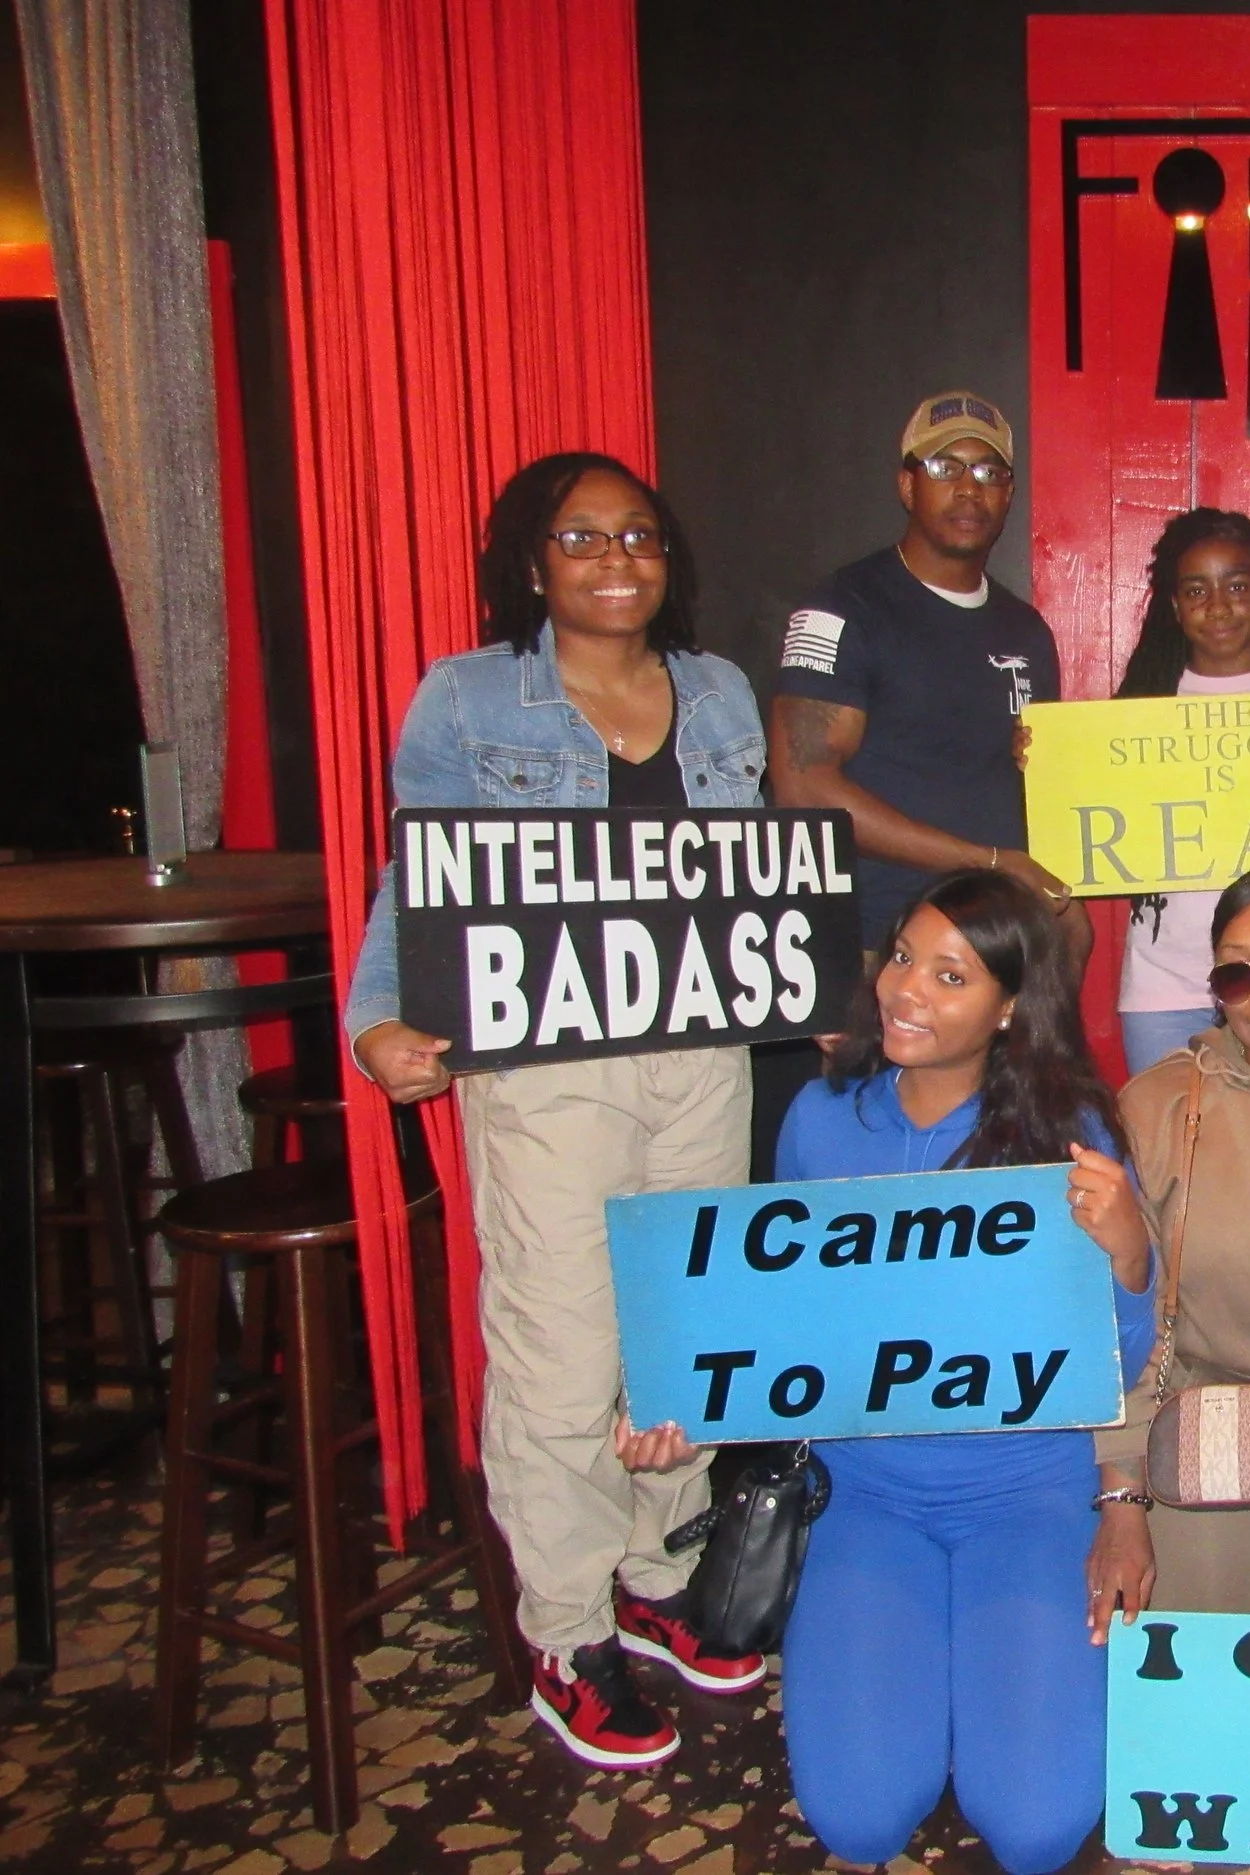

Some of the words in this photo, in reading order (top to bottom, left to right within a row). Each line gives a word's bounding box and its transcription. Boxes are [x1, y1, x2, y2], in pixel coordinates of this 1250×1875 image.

[1204, 765, 1236, 793] IS
[405, 820, 853, 909] INTELLECTUAL
[465, 910, 817, 1052] BADASS
[685, 1205, 719, 1278] I
[743, 1198, 1037, 1273] Came
[692, 1349, 826, 1423] To
[865, 1338, 1071, 1426] Pay
[1135, 1622, 1184, 1681] I
